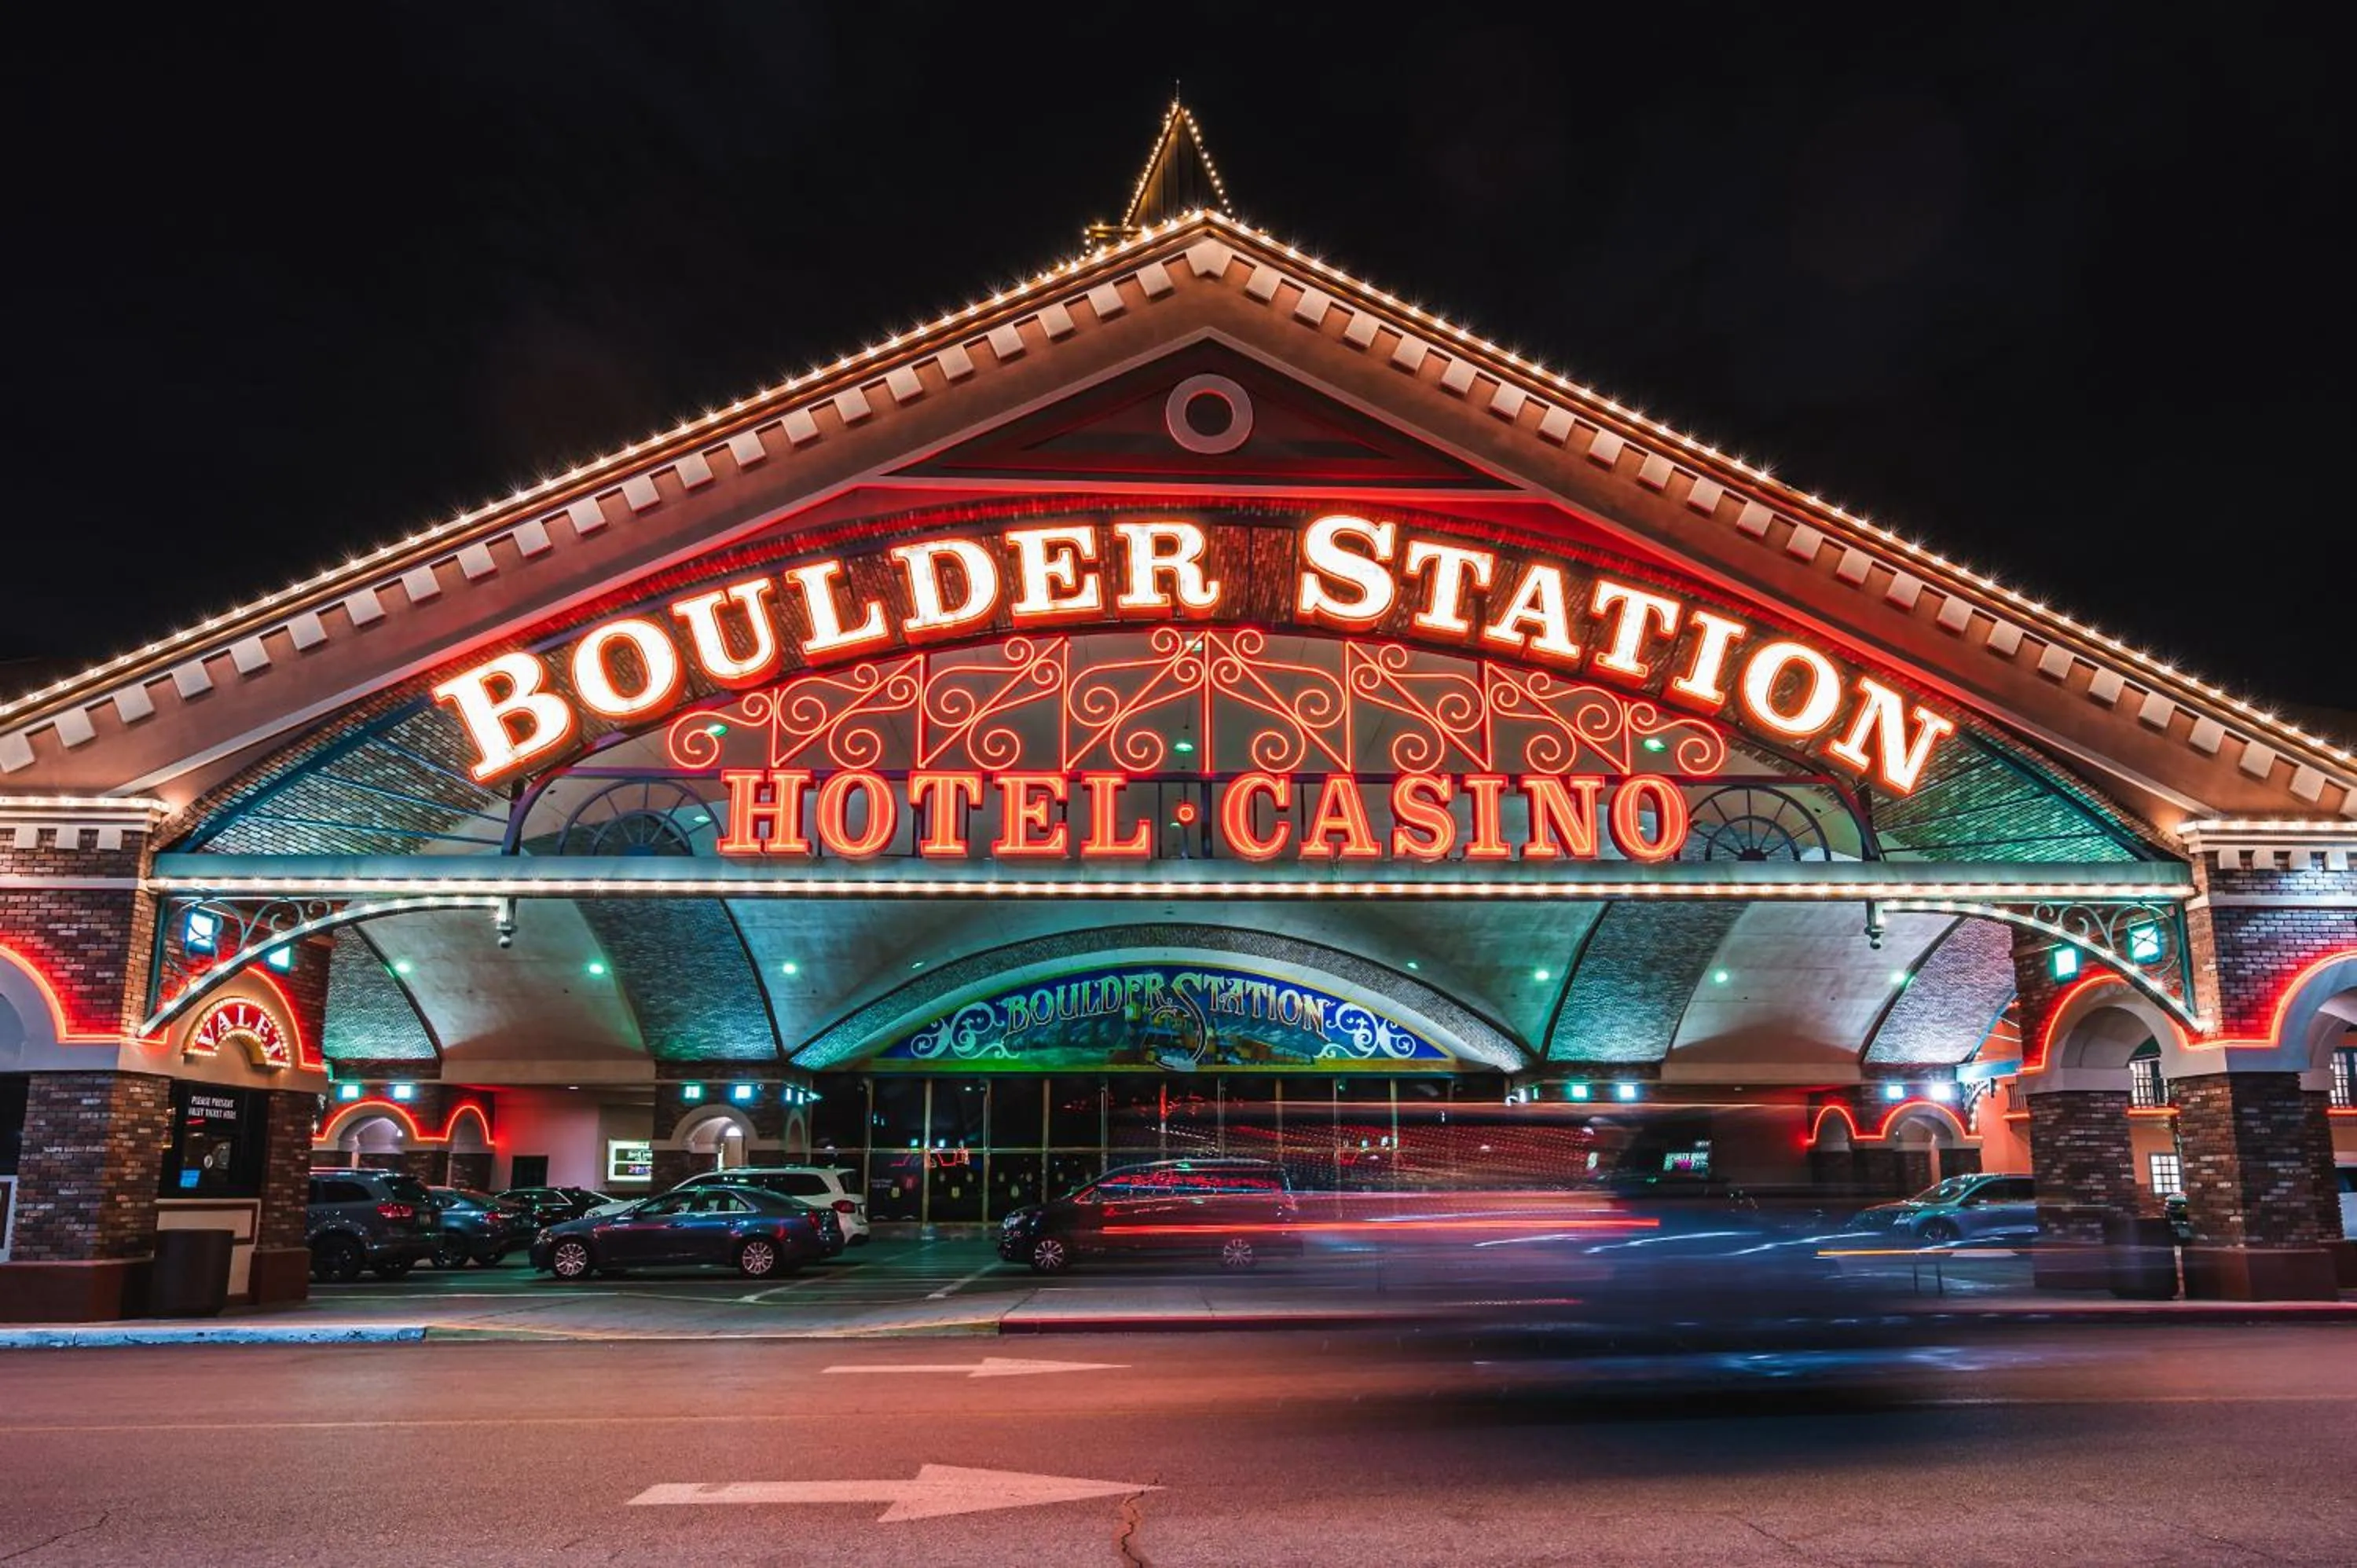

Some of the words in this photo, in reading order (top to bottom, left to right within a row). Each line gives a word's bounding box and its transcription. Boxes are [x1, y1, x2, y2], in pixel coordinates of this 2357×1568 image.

[433, 520, 1221, 786] BOULDER
[1299, 515, 1954, 795] STATION
[717, 769, 1152, 859] HOTEL
[1221, 773, 1692, 862] CASINO
[196, 1005, 284, 1057] VALET
[996, 973, 1175, 1043] BOULDER
[1153, 973, 1336, 1068] STATION
